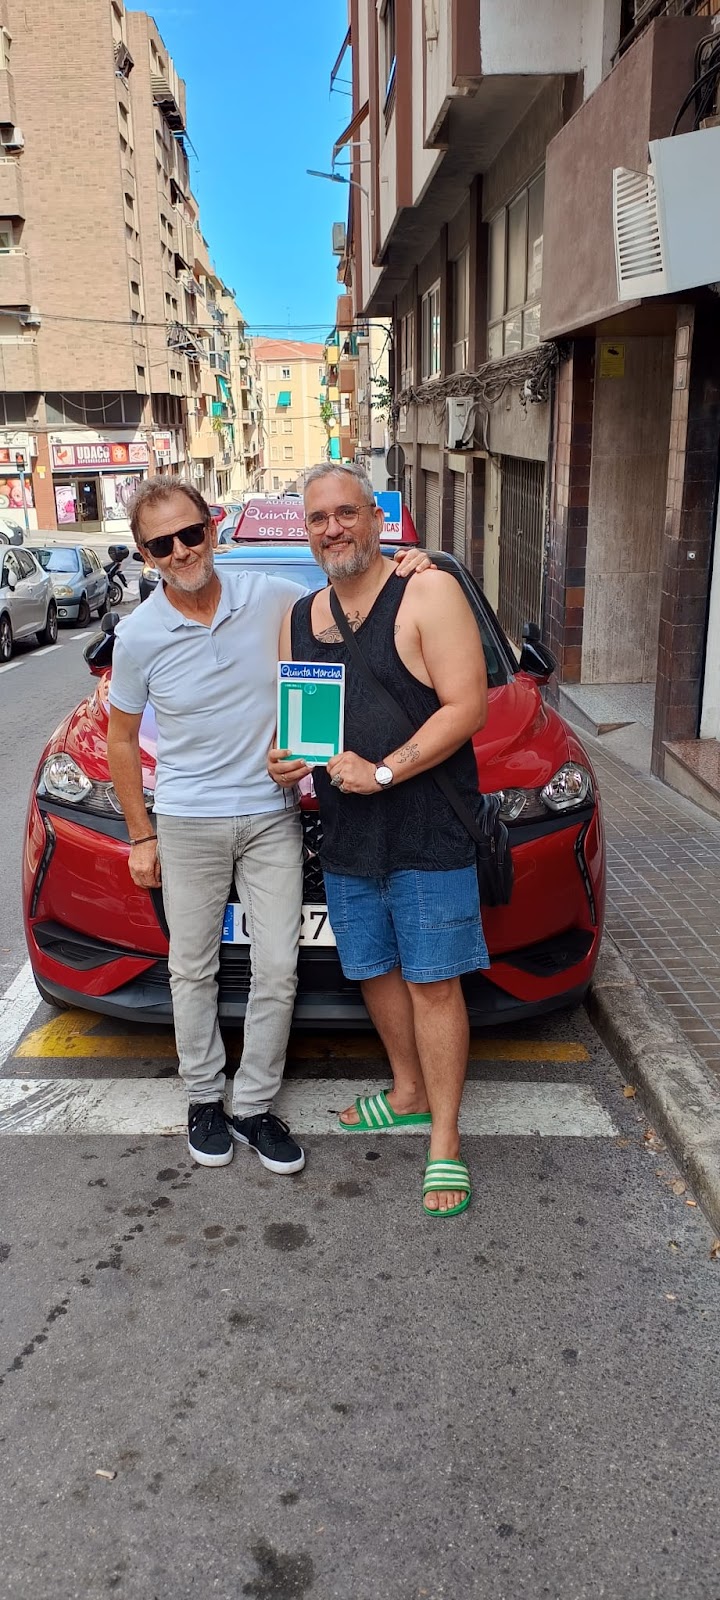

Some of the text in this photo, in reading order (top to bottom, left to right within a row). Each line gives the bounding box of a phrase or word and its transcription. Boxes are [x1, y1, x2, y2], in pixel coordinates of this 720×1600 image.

[76, 445, 110, 460] UDACO
[244, 506, 300, 520] Quinta
[258, 526, 308, 537] 965 25
[383, 522, 400, 533] ICAS
[281, 664, 342, 679] Quinta Marcha
[287, 688, 335, 757] L
[223, 927, 229, 935] E
